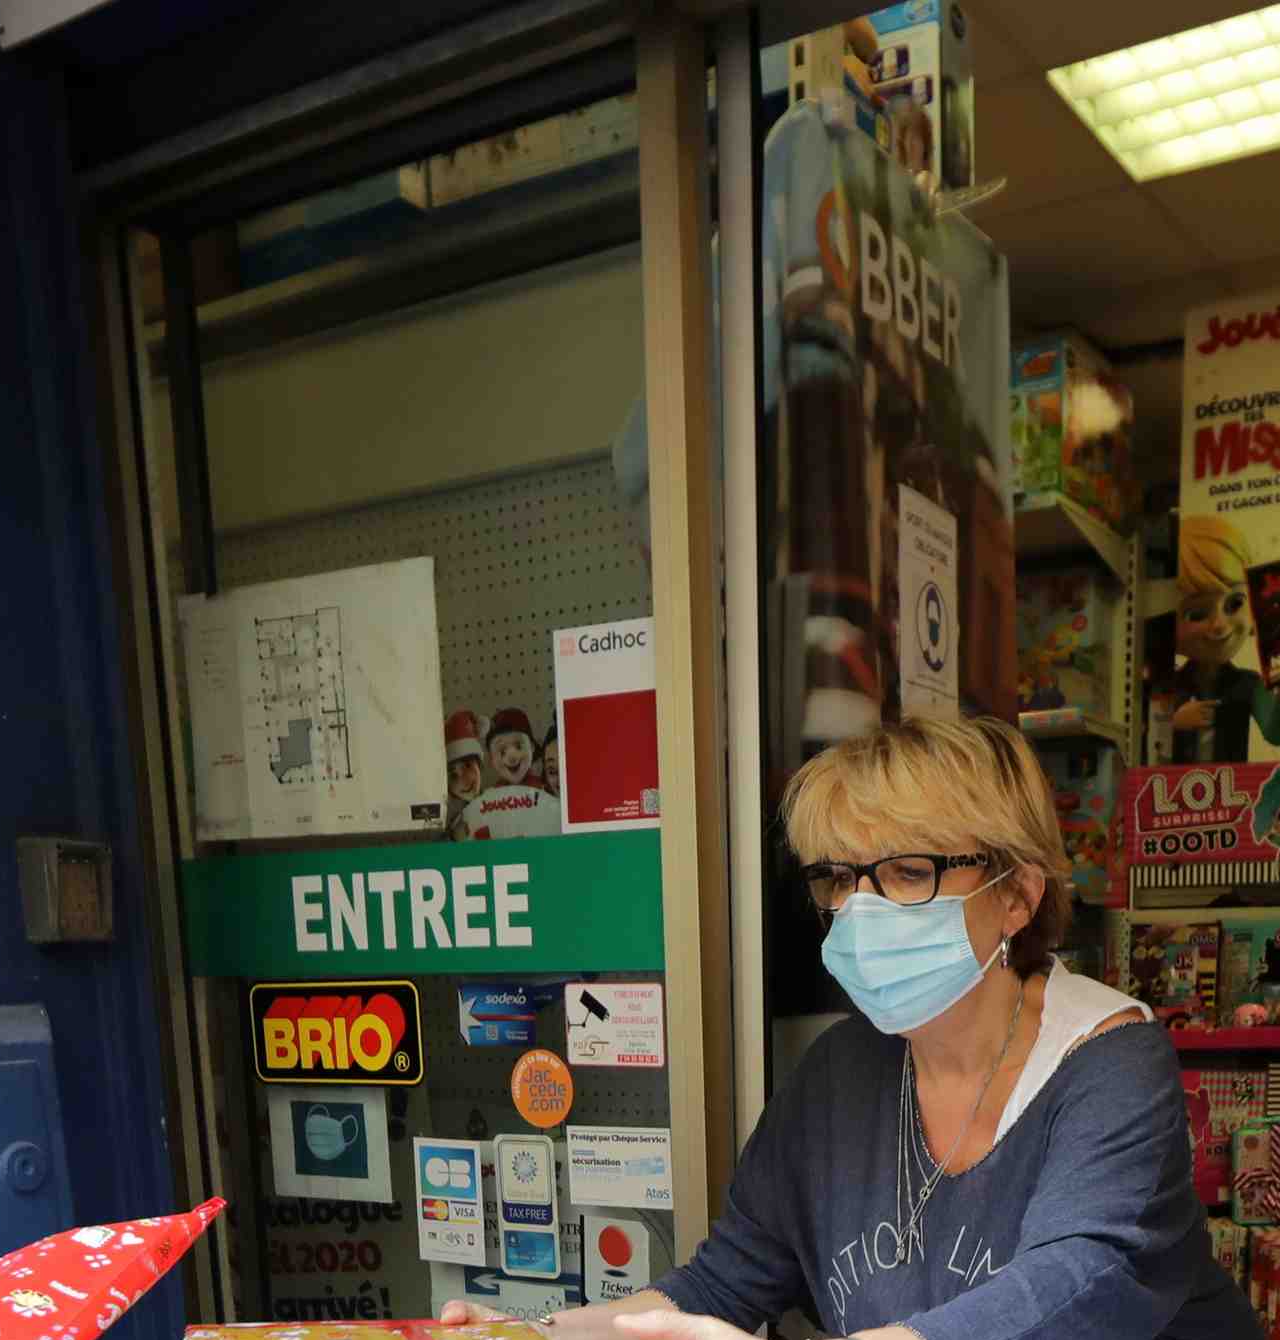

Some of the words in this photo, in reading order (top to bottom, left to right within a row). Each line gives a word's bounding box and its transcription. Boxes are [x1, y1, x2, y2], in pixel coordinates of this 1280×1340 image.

[578, 628, 647, 654] Cadhoc
[1144, 828, 1236, 855] #OOTD
[291, 863, 533, 953] ENTREE
[485, 990, 528, 1005] sodexo
[263, 1000, 402, 1072] BRIO
[640, 1136, 668, 1145] Service
[571, 1156, 622, 1167] sécurisation
[454, 1206, 476, 1218] VISA
[508, 1207, 524, 1219] TAX
[525, 1208, 548, 1221] FREE
[600, 1280, 634, 1296] Ticket
